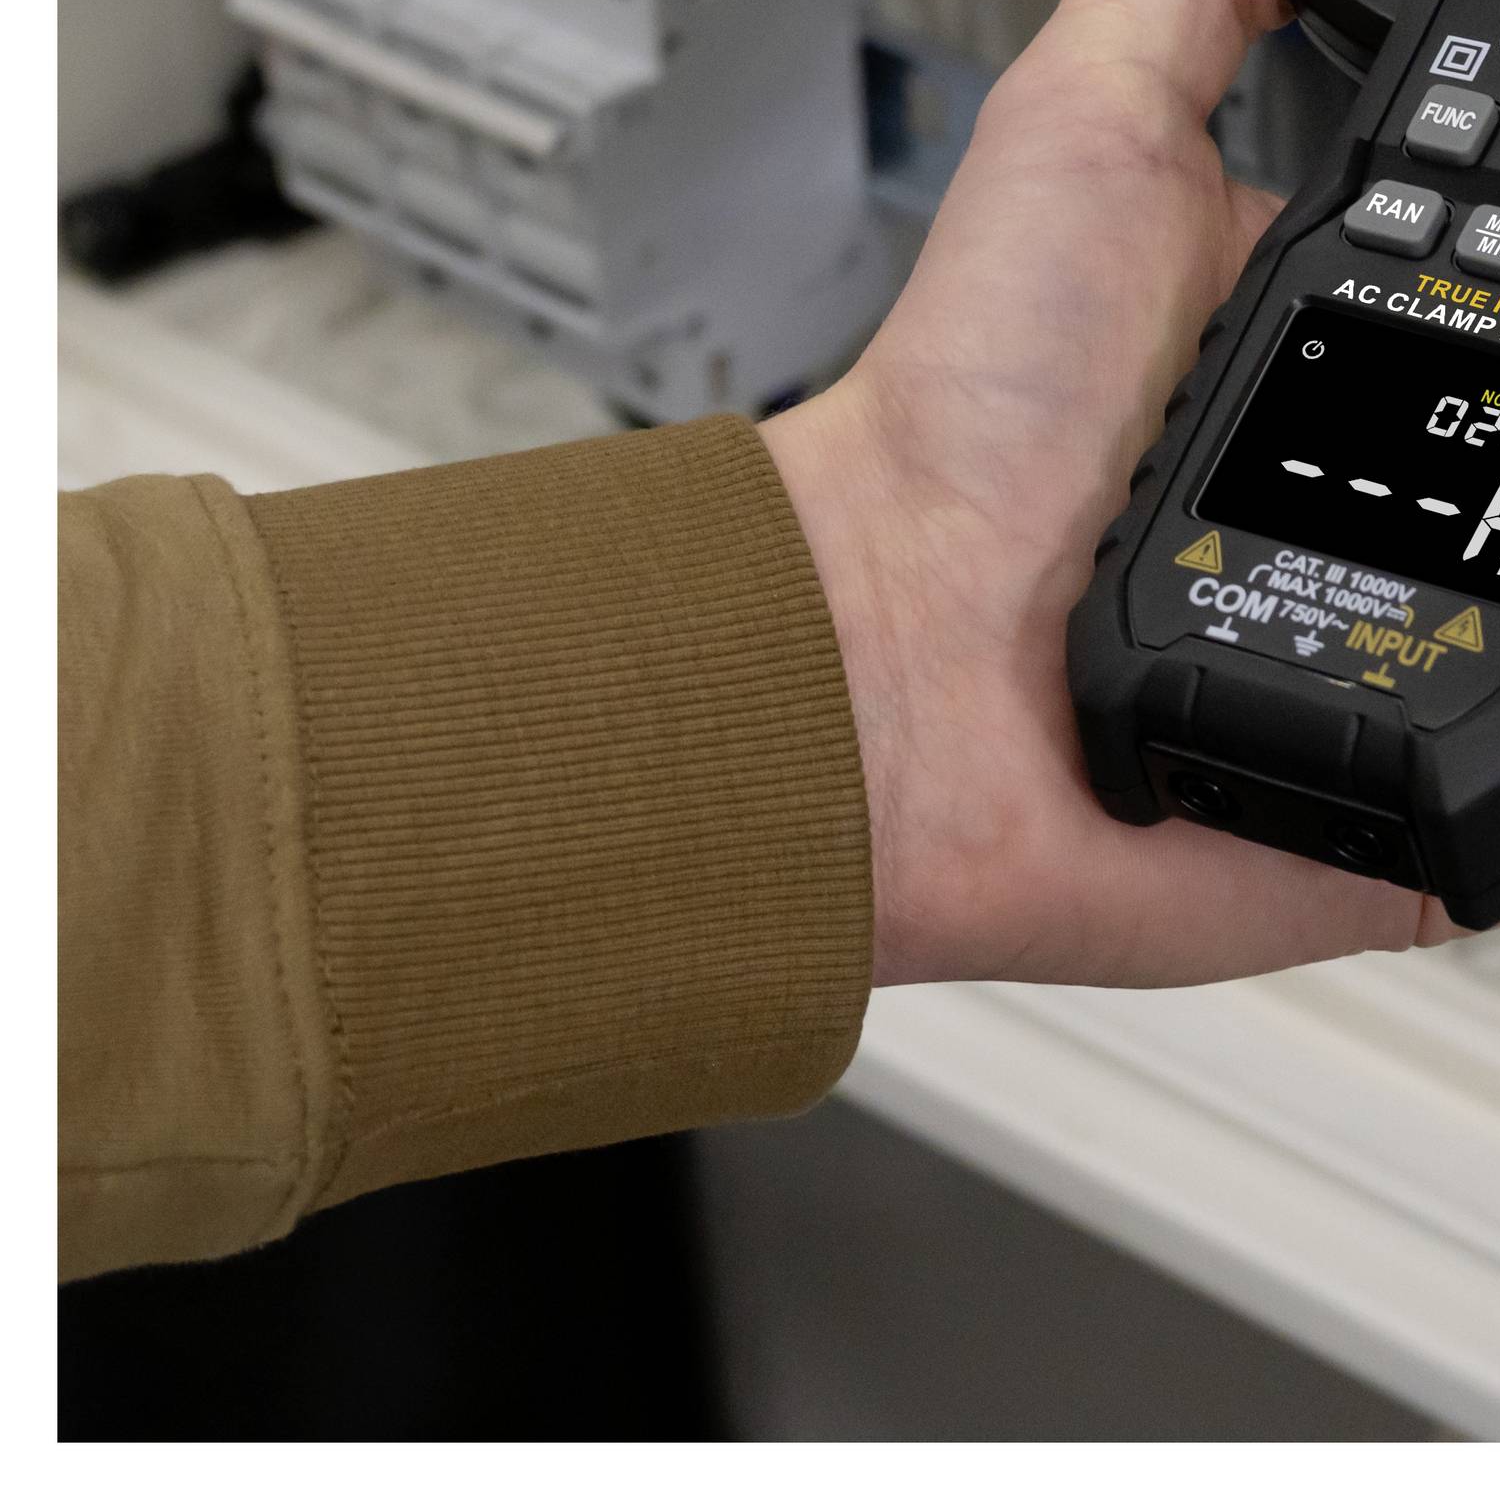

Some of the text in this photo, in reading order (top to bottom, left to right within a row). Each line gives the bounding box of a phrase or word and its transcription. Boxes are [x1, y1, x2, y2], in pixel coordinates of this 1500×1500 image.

[1420, 101, 1477, 132] FUNC
[1366, 192, 1425, 223] RAN
[1332, 278, 1382, 305] AC
[1386, 291, 1498, 335] CLAMP
[1416, 274, 1492, 310] TRUE
[1187, 577, 1278, 624] COM
[1268, 569, 1324, 600] MAX
[1325, 563, 1347, 583] III
[1350, 572, 1417, 603] 1000V
[1346, 620, 1448, 673] INPUT
